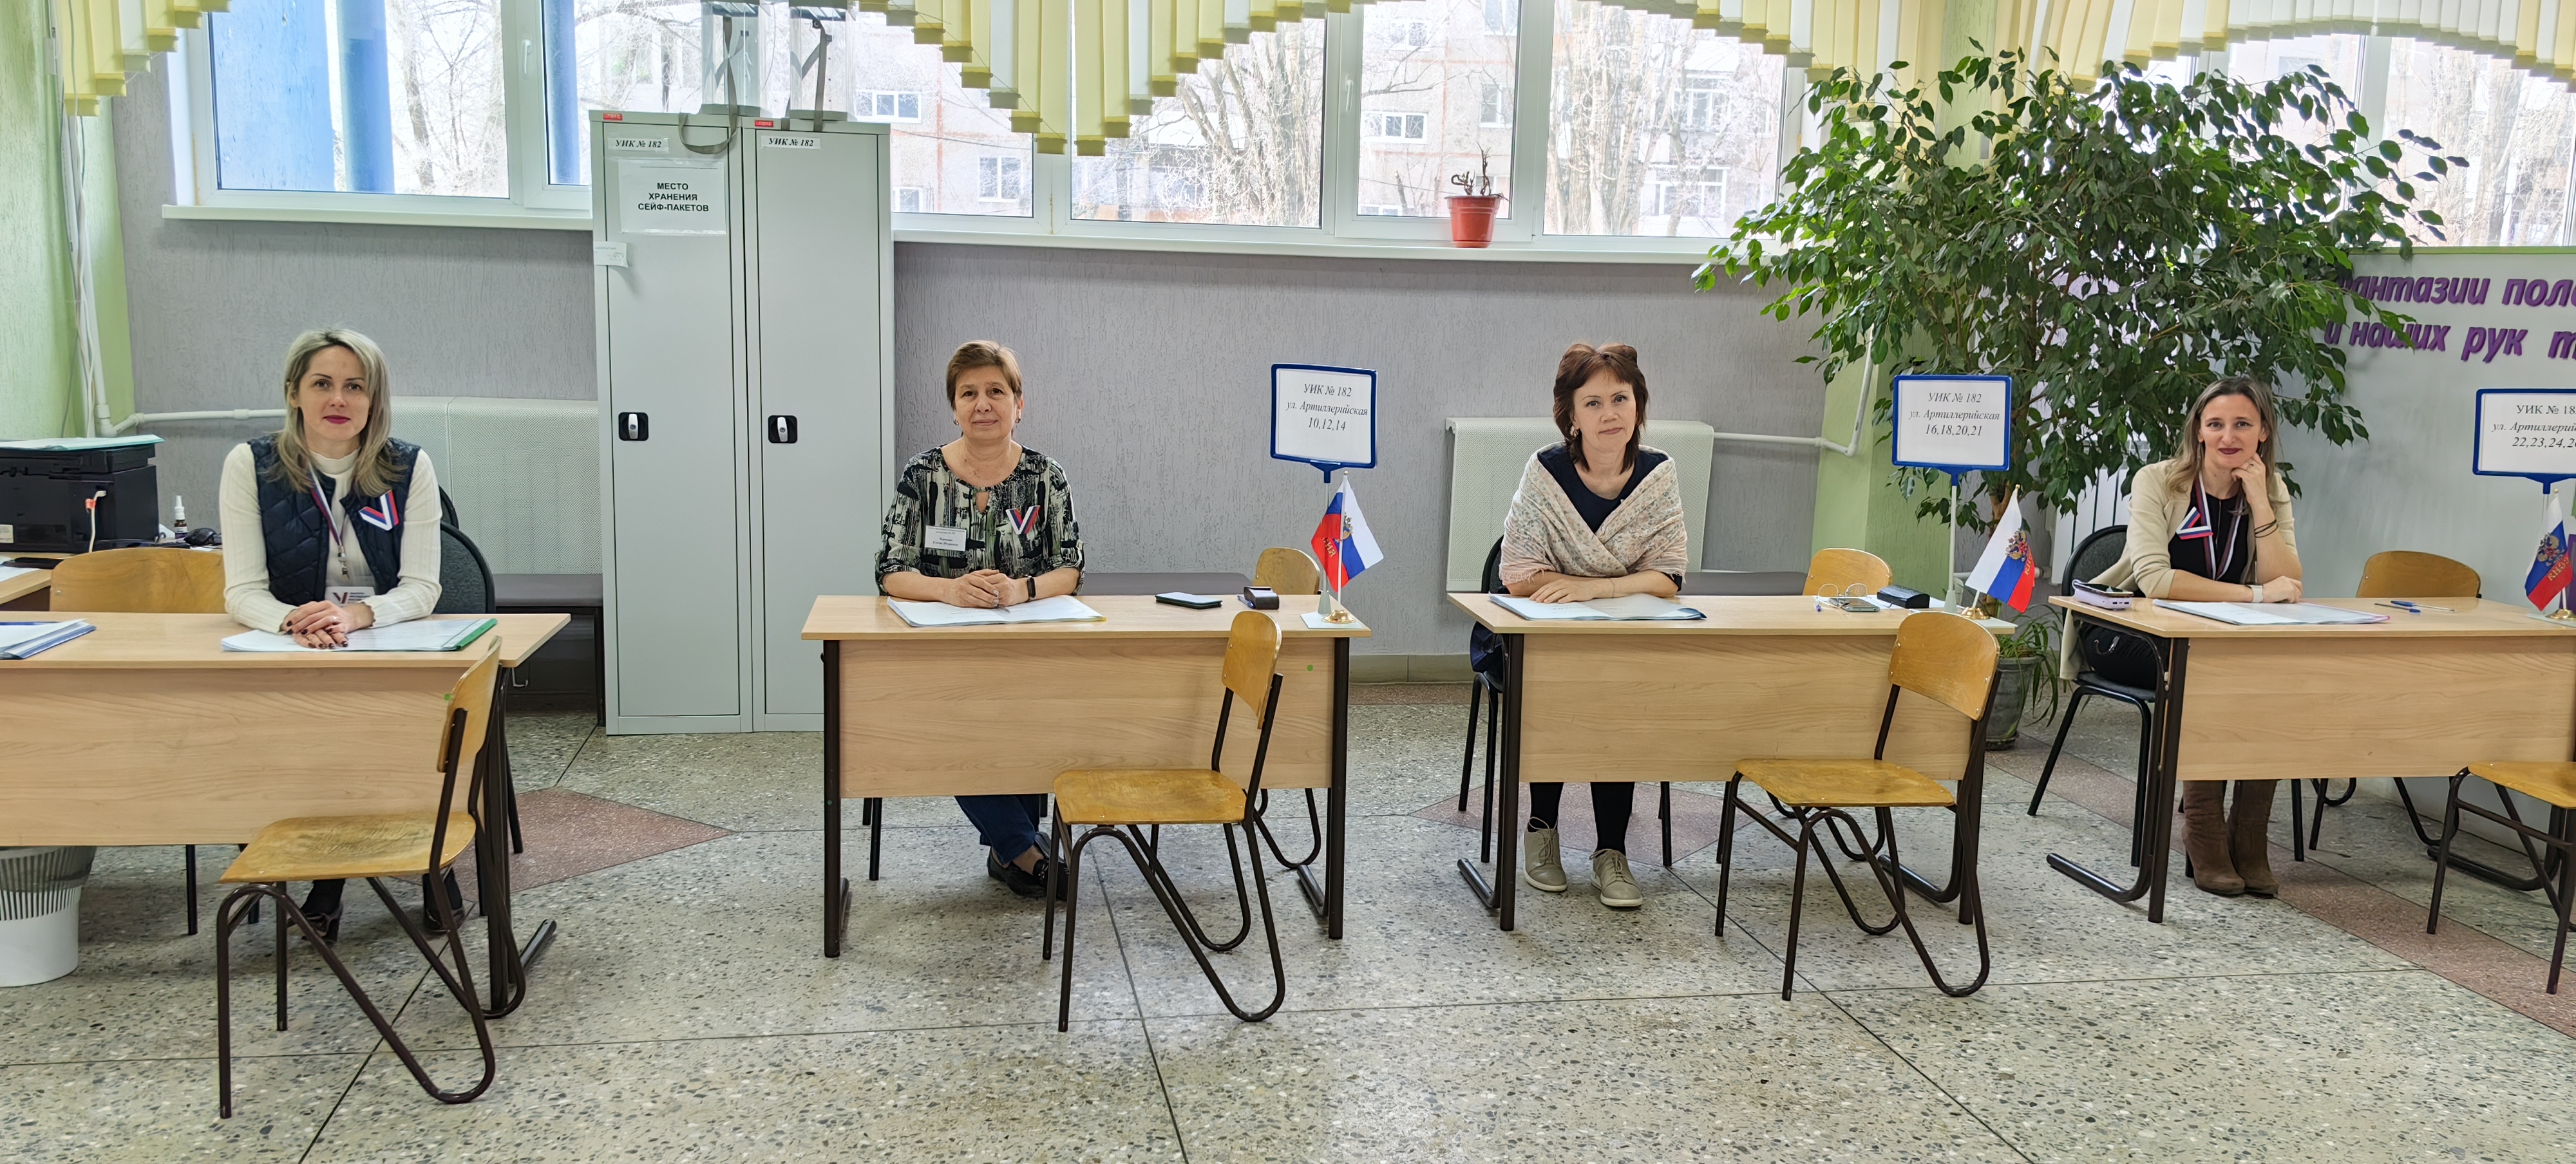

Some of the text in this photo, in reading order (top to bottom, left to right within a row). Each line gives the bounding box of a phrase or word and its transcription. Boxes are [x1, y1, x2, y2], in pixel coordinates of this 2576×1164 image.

[615, 139, 636, 147] УИК
[657, 182, 688, 191] МЕСТО
[649, 192, 697, 201] ХРАНЕНИЯ
[638, 202, 709, 212] СЕЙФ-ПАКЕТОВ
[2338, 276, 2576, 308] антазии пол
[2324, 321, 2343, 345] и
[2461, 326, 2529, 364] рук
[1304, 384, 1352, 397] УИК № 182
[1928, 392, 1982, 403] УИК № 182
[1285, 401, 1368, 416] ул. Артиллерийская
[2517, 405, 2576, 415] УИК № 18
[1908, 409, 2000, 421] ул. Артиллерийская
[1308, 417, 1346, 431] 10,12,14
[1926, 424, 1982, 436] 16,18,20,21
[2492, 424, 2506, 433] ул.
[2512, 437, 2576, 449] 22,23,24,2
